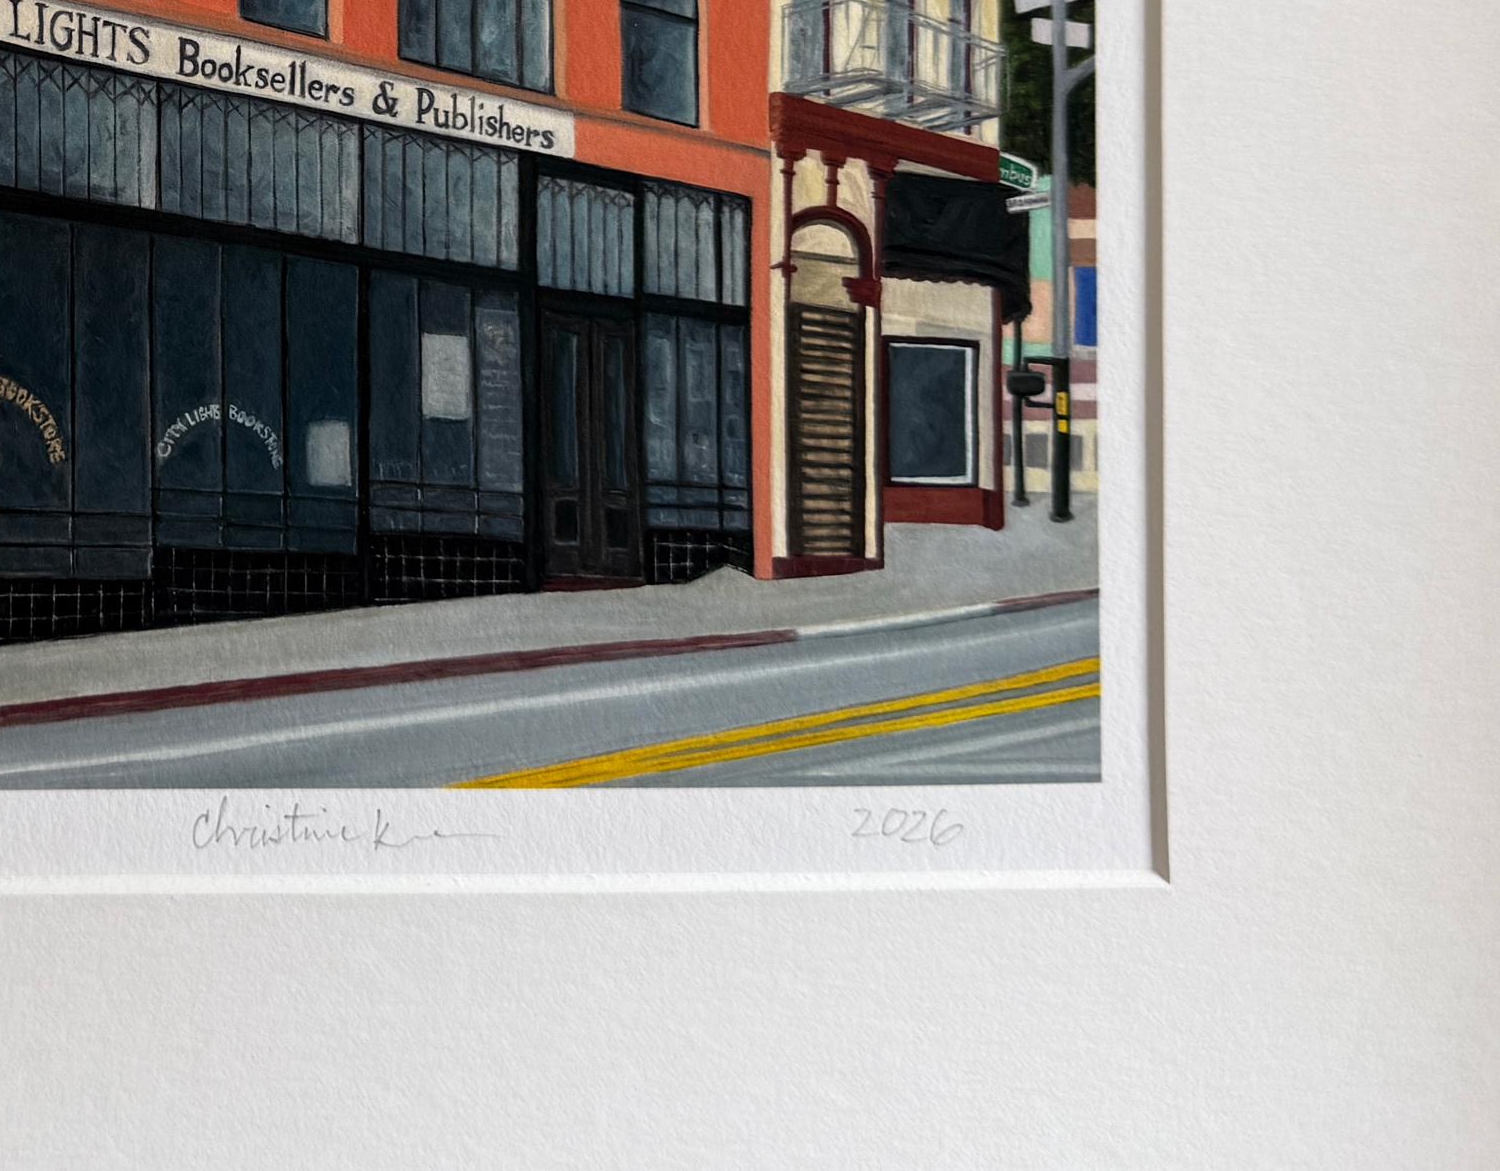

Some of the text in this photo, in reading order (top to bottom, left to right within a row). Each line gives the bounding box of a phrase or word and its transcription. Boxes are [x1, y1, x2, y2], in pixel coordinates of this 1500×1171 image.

[175, 35, 356, 107] Booksellers
[372, 80, 399, 118] &
[415, 86, 556, 150] Publishers
[157, 417, 188, 457] CITY
[851, 807, 965, 849] 2026
